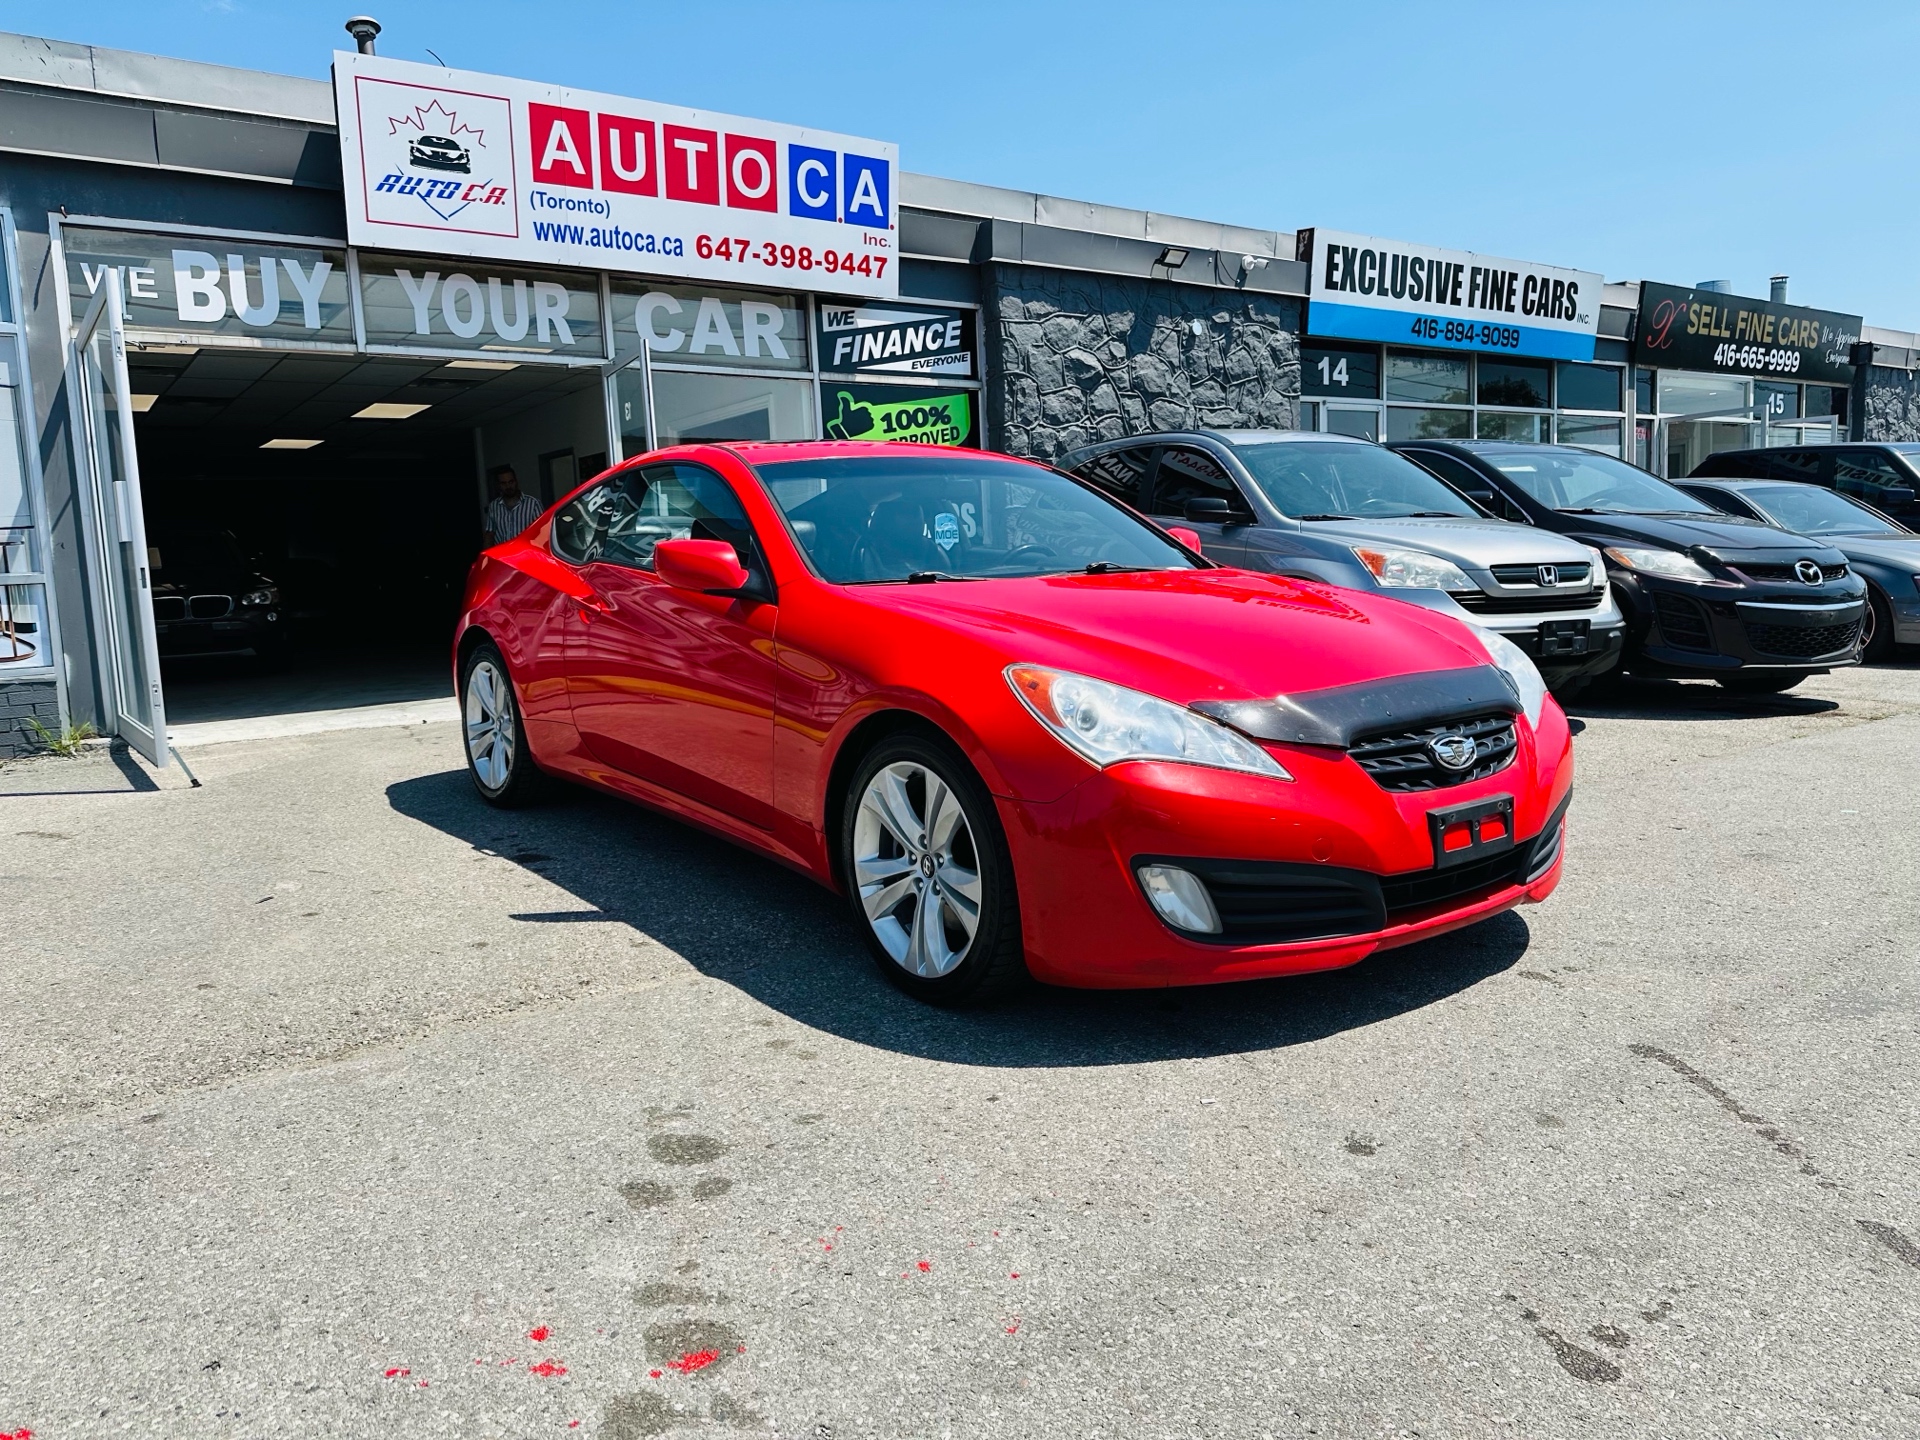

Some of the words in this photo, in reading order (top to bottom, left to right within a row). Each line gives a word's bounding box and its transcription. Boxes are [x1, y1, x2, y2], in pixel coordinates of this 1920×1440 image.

[375, 174, 462, 199] AUTO
[530, 190, 611, 219] (Toronto)
[533, 221, 684, 257] www.autoca.ca
[863, 232, 892, 248] Inc.
[695, 234, 888, 279] 647-398-9447
[1325, 243, 1464, 307] EXCLUSIVE
[1468, 266, 1518, 313] FINE
[1522, 274, 1578, 322] CARS
[1577, 312, 1590, 325] INC.
[171, 249, 332, 329] BUY
[394, 269, 575, 344] YOUR
[634, 291, 790, 359] CAR
[827, 310, 855, 328] WE
[833, 319, 962, 366] FINANCE
[1411, 317, 1520, 349] 416-894-9099
[1735, 310, 1776, 344] FINE
[1778, 316, 1819, 349] CARS
[911, 353, 969, 370] EVERYONE
[1317, 356, 1349, 387] 14
[1713, 343, 1800, 373] 416-665-9999
[1768, 393, 1785, 414] 15
[880, 404, 952, 434] 100%
